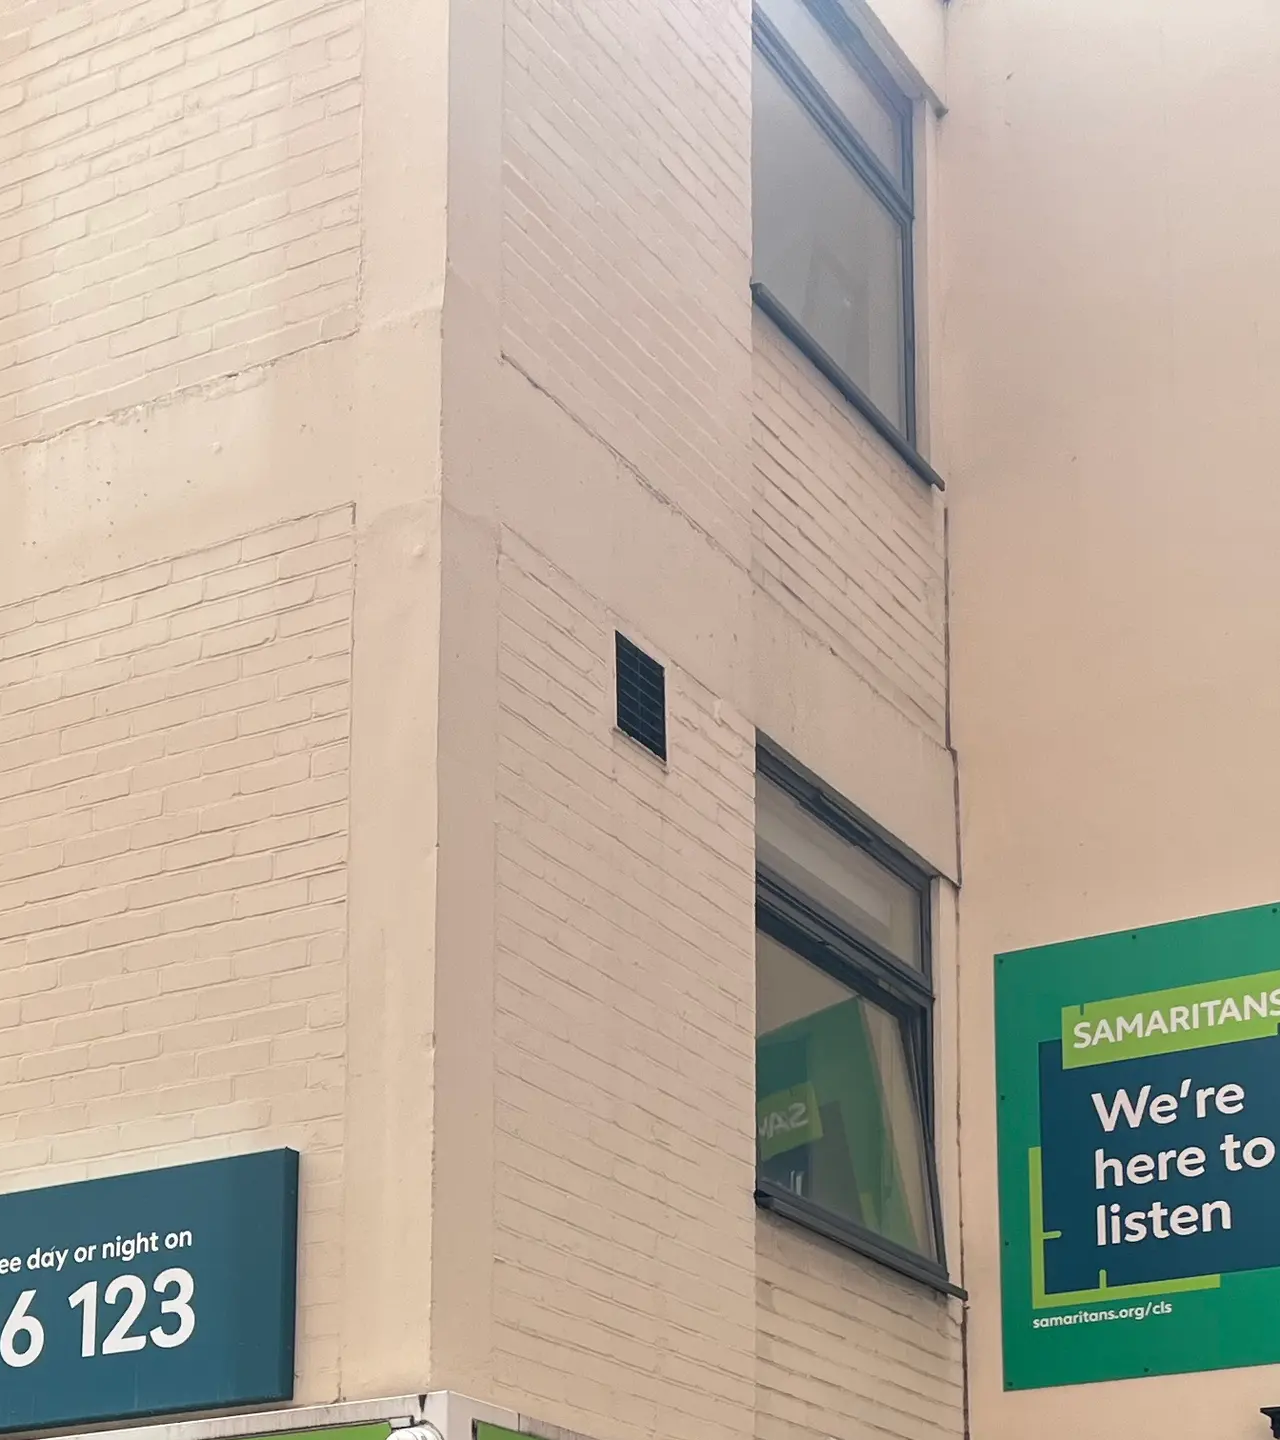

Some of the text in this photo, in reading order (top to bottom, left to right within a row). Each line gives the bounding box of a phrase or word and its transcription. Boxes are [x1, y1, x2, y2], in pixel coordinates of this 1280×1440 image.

[1091, 1079, 1246, 1133] We're
[1094, 1132, 1276, 1190] here to
[1095, 1198, 1232, 1246] listen
[26, 1246, 69, 1272] day
[73, 1246, 97, 1263] or
[102, 1231, 160, 1262] night
[164, 1229, 193, 1249] on
[67, 1267, 196, 1357] 123
[1032, 1301, 1172, 1329] samaritans.org/cls
